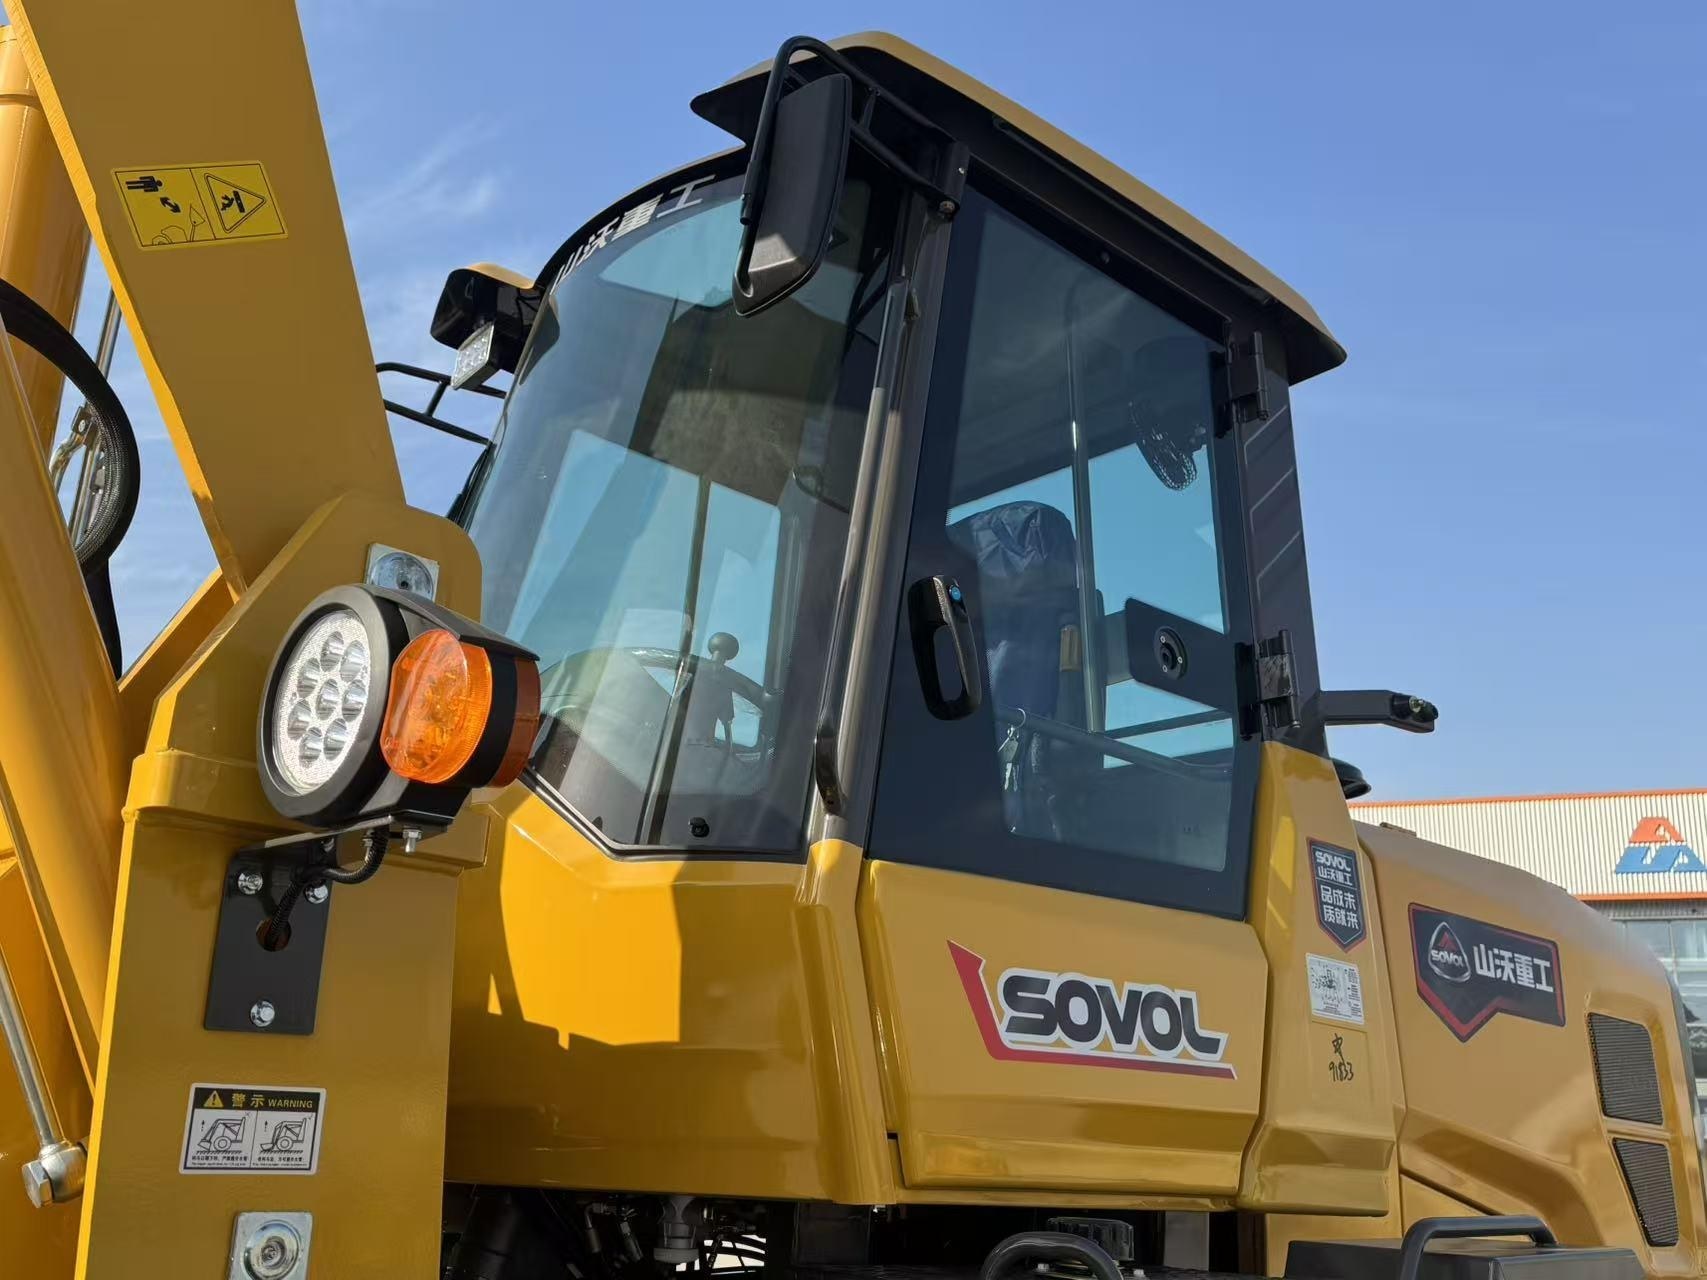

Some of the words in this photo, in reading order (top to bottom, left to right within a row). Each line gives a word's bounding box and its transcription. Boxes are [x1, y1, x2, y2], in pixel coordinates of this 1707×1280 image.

[550, 174, 716, 295] 山沃重工
[1315, 851, 1351, 872] SOVOL
[1317, 866, 1353, 886] 山沃重工
[1472, 943, 1554, 993] 山沃重工
[1000, 972, 1223, 1056] SOVOL
[268, 1098, 313, 1109] WARNING
